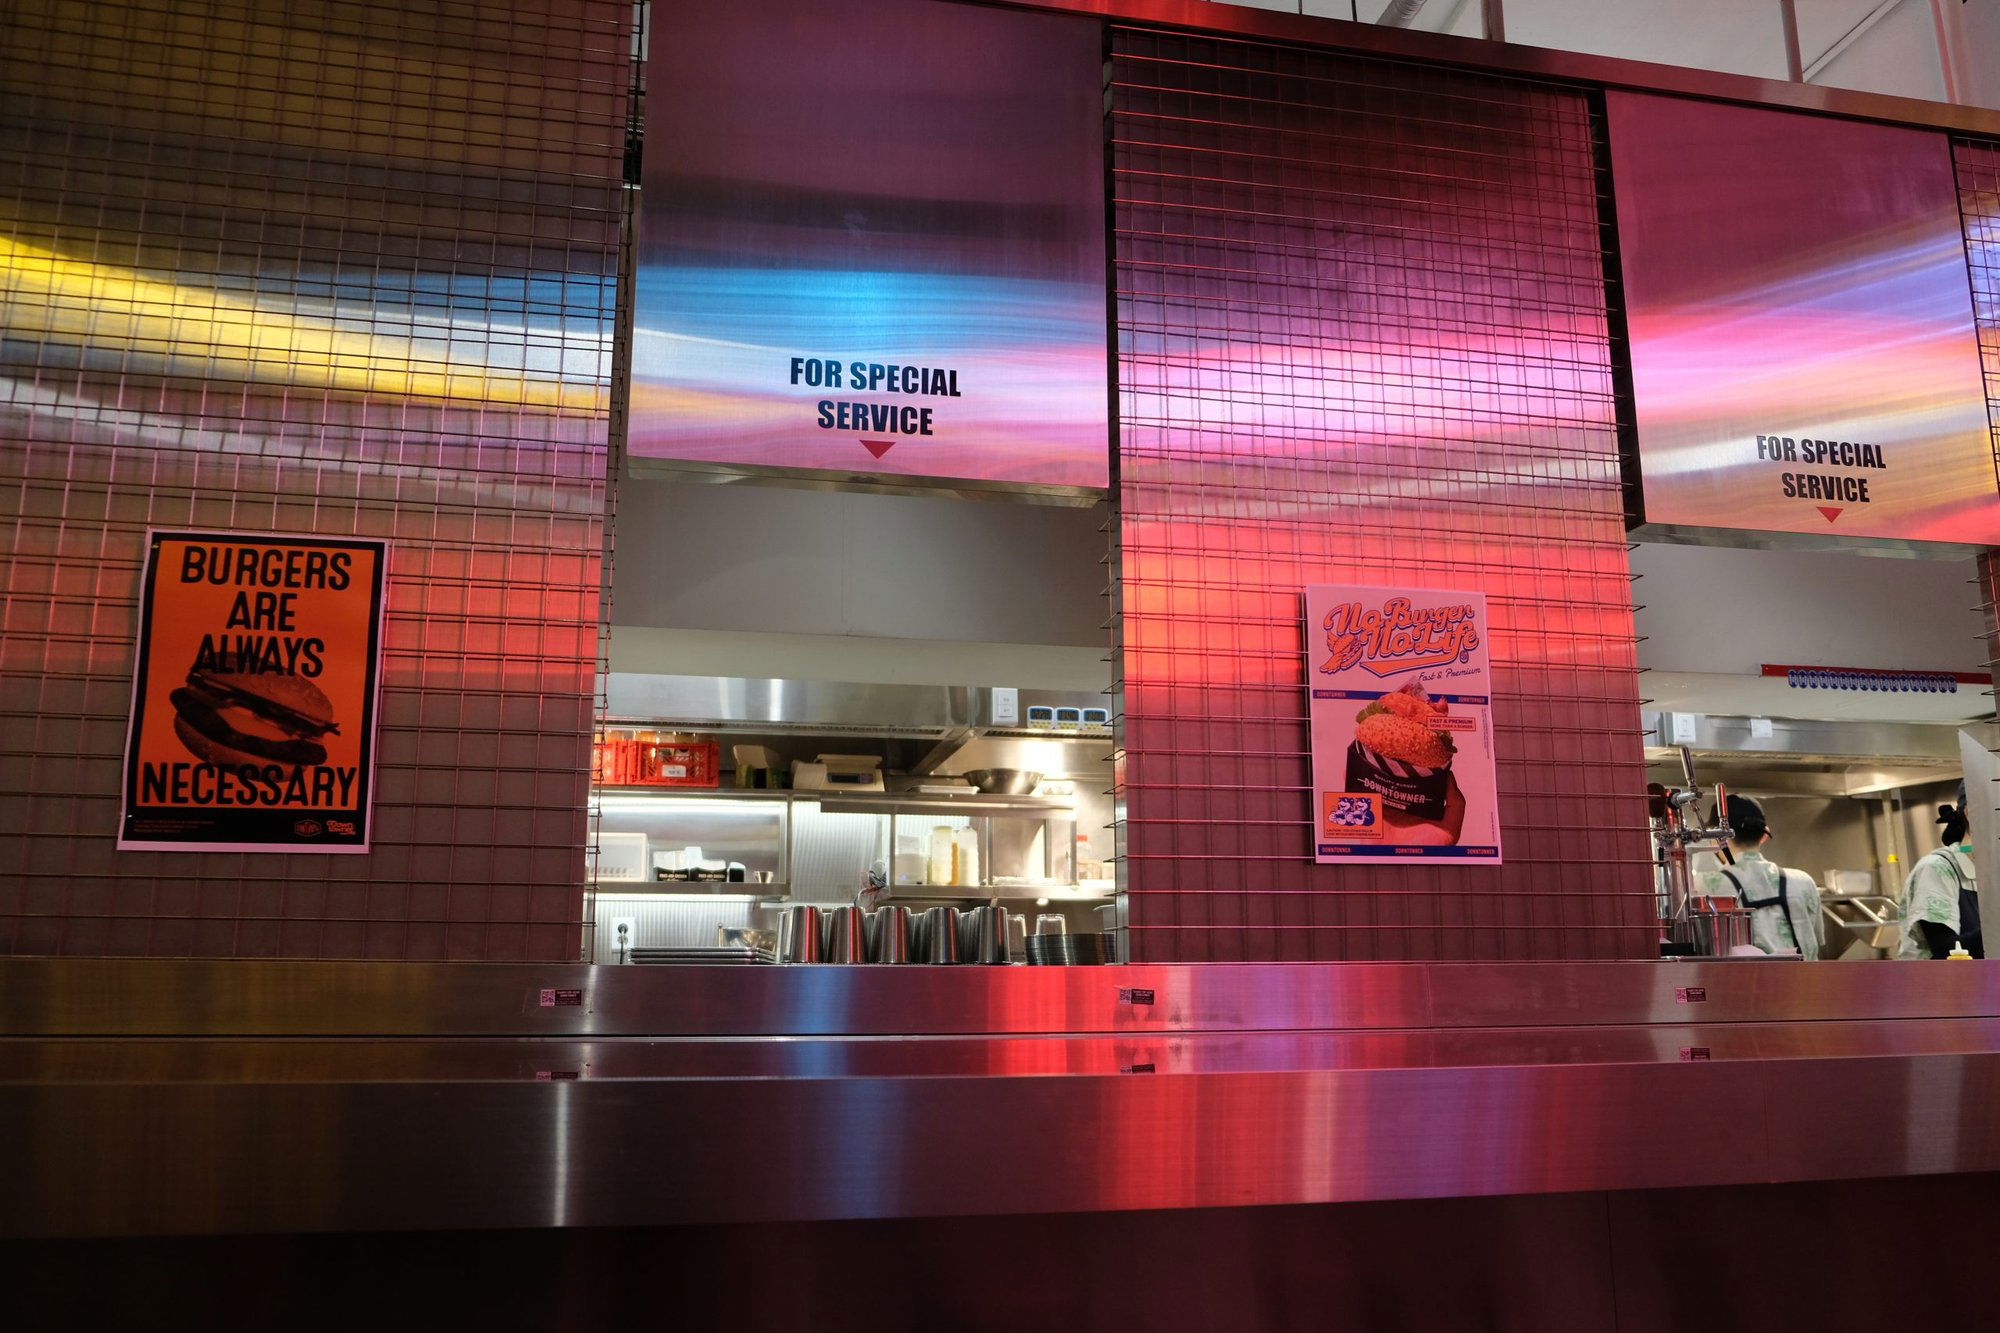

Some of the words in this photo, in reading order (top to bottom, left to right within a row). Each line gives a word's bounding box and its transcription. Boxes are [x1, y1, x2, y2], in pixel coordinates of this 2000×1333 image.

[791, 357, 842, 388] FOR
[850, 362, 961, 397] SPECIAL
[818, 400, 933, 436] SERVICE
[1756, 435, 1797, 462] FOR
[1801, 439, 1886, 469] SPECIAL
[1782, 472, 1870, 503] SERVICE
[180, 545, 351, 591] BURGERS
[226, 591, 297, 632] ARE
[1323, 602, 1381, 636] No
[1384, 597, 1475, 632] Burger
[193, 634, 324, 678] ALWAYS
[1360, 623, 1413, 659] No
[1412, 620, 1480, 658] Life
[1418, 671, 1435, 682] Fast
[1445, 667, 1481, 678] Premium
[142, 762, 357, 807] NECESSARY
[1364, 777, 1426, 804] DOWNTOWNER
